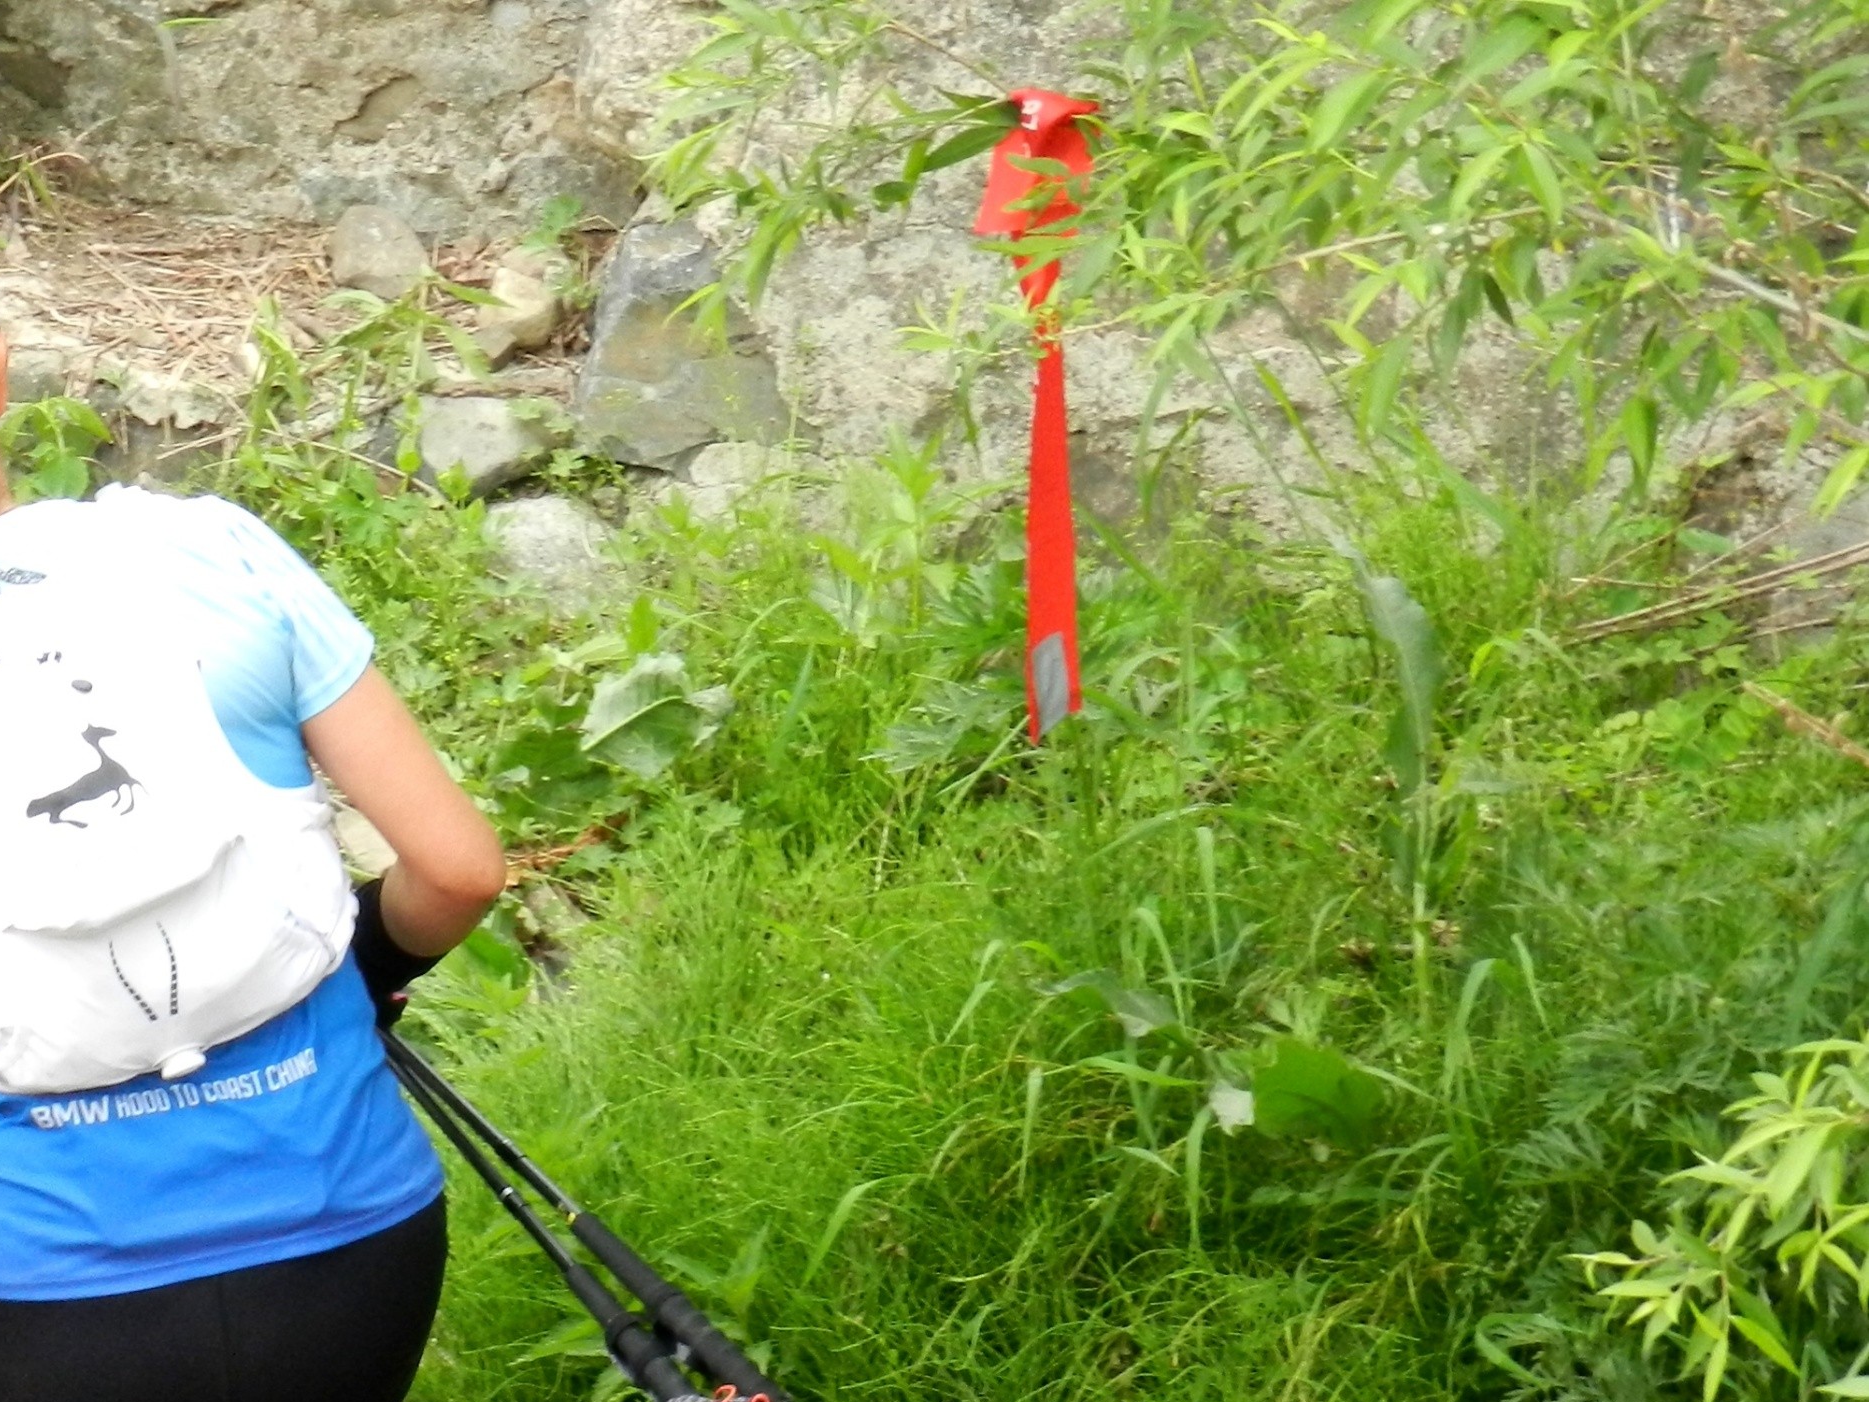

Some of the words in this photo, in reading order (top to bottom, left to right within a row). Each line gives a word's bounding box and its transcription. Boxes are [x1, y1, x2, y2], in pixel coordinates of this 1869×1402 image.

[30, 1095, 109, 1129] BMW
[116, 1088, 171, 1119] HOOD
[171, 1083, 200, 1109] TO
[201, 1070, 263, 1103] COAST
